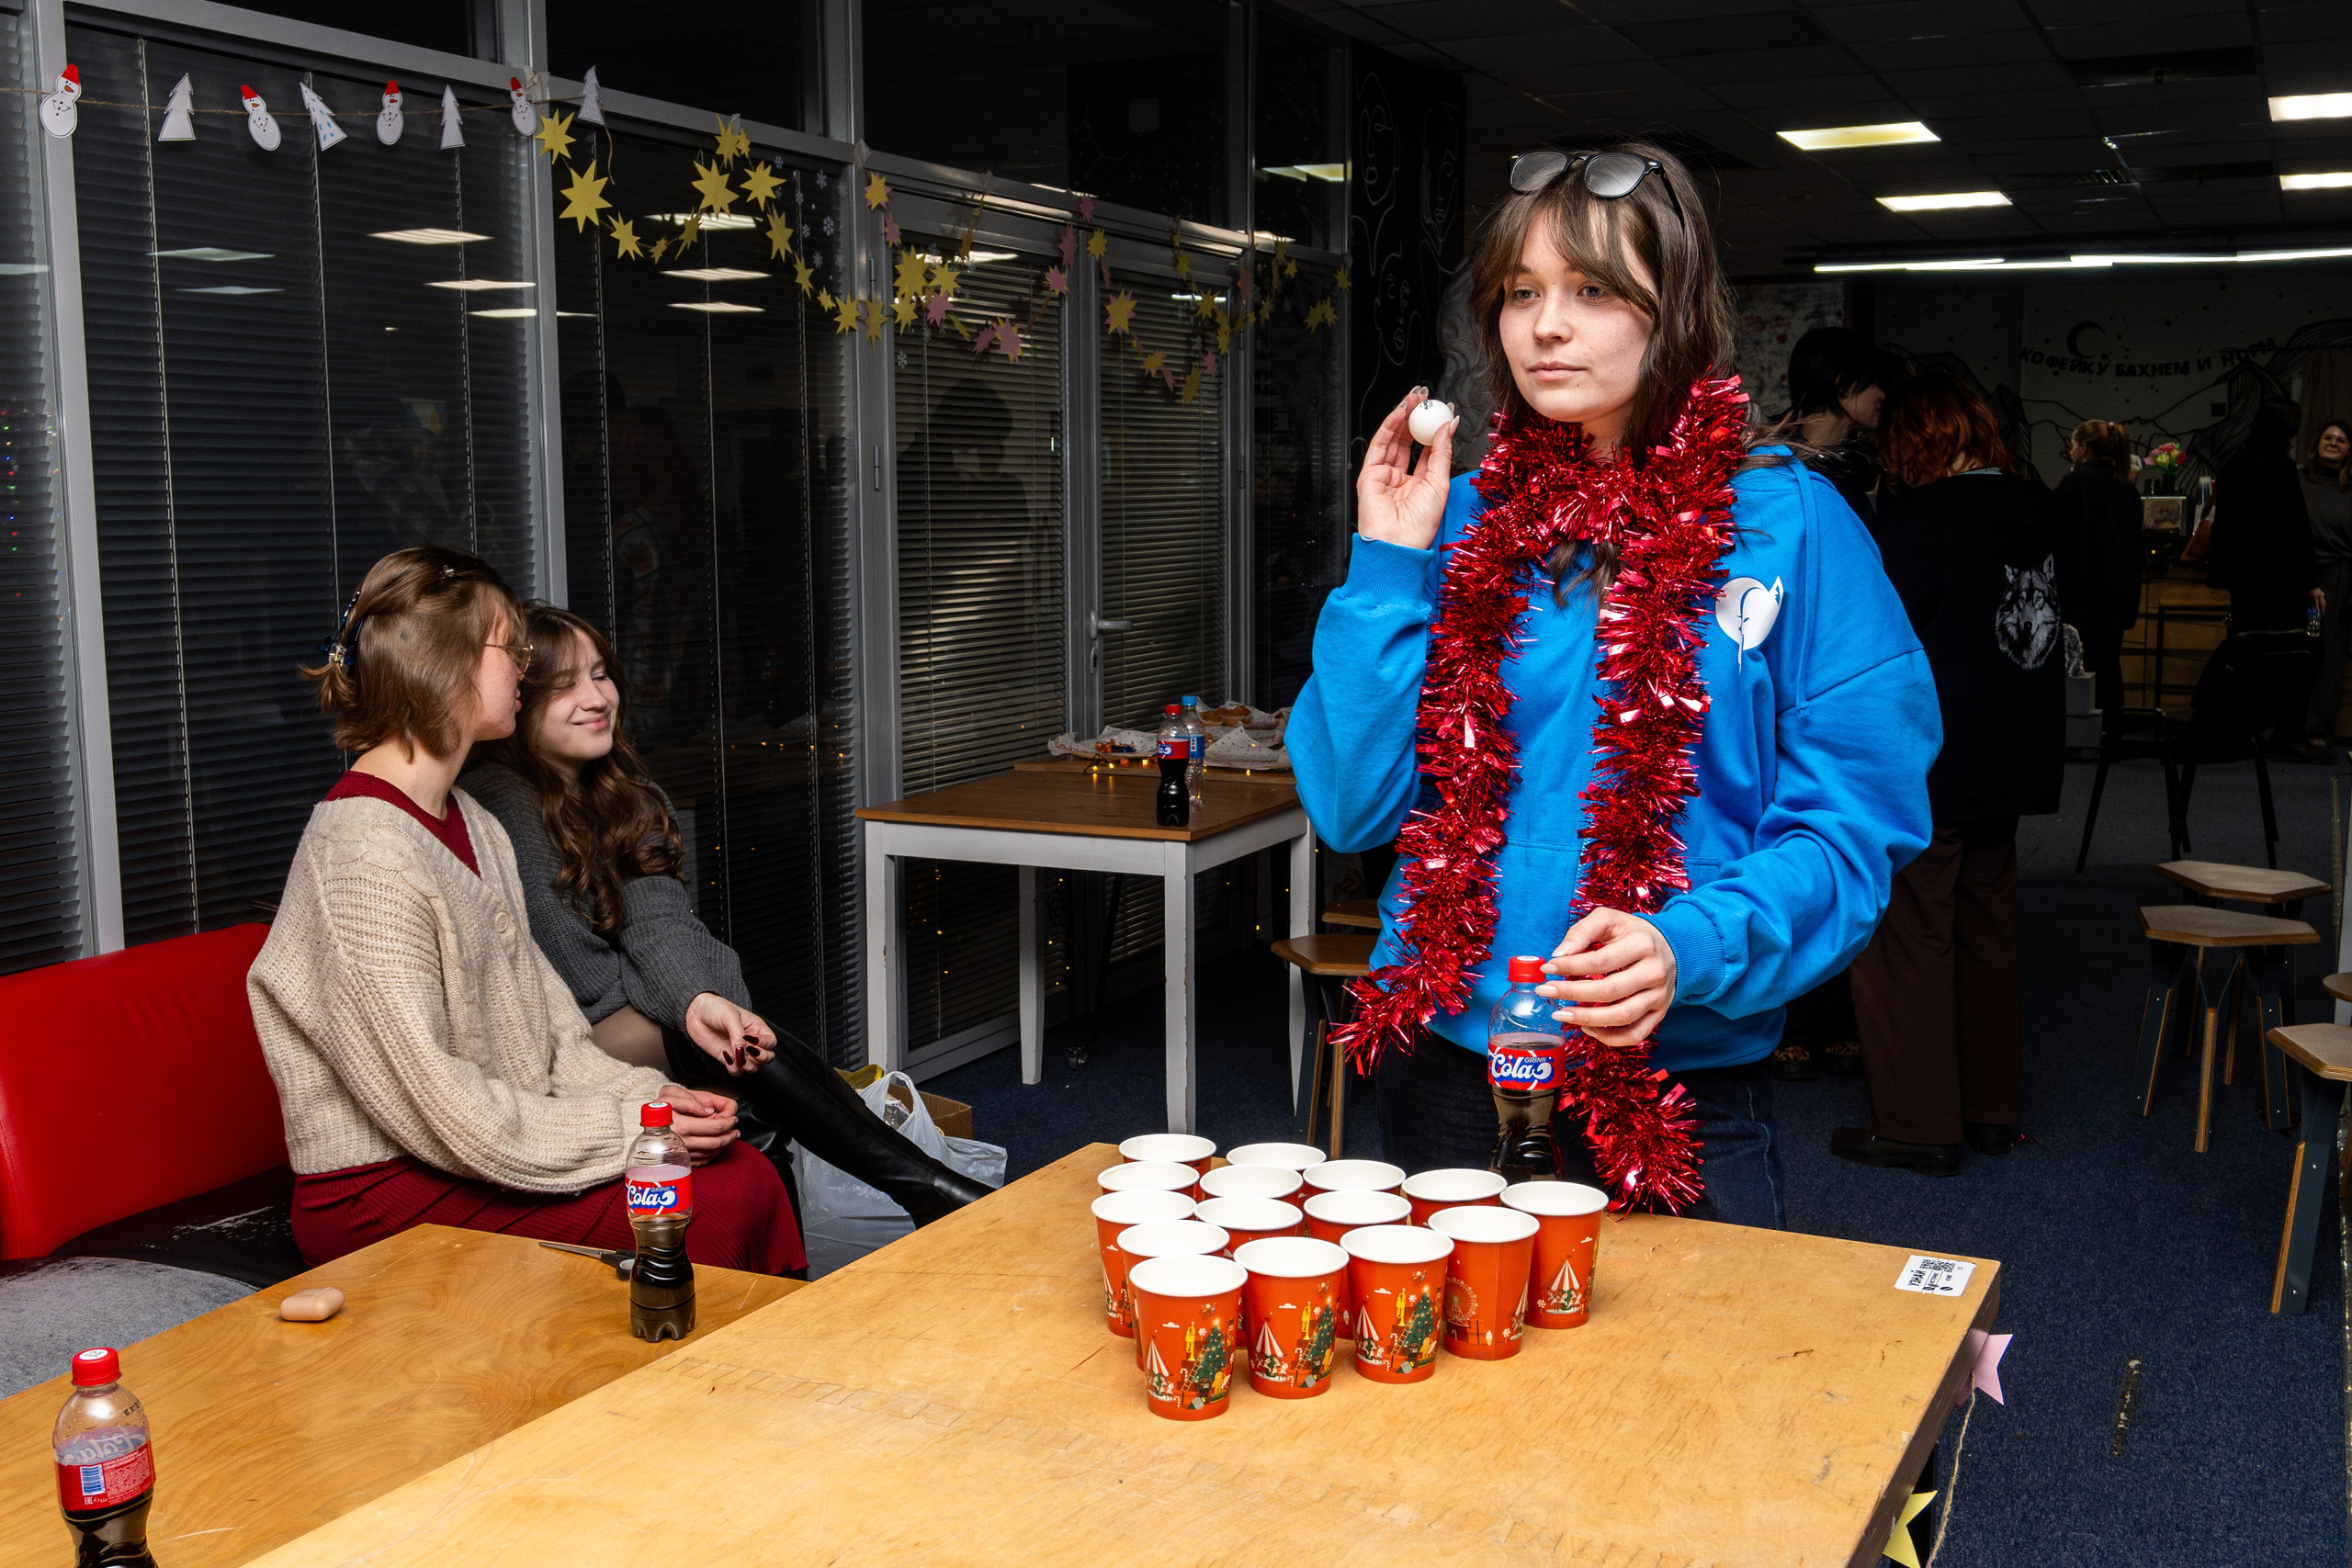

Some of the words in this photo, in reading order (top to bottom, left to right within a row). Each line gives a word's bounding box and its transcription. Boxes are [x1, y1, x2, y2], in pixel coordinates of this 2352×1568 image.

[2019, 346, 2109, 377] КОФЕЙКУ
[2115, 360, 2190, 378] БАХНЕМ
[2198, 357, 2211, 371] И
[1491, 1053, 1552, 1080] Cola
[627, 1185, 675, 1206] Cola
